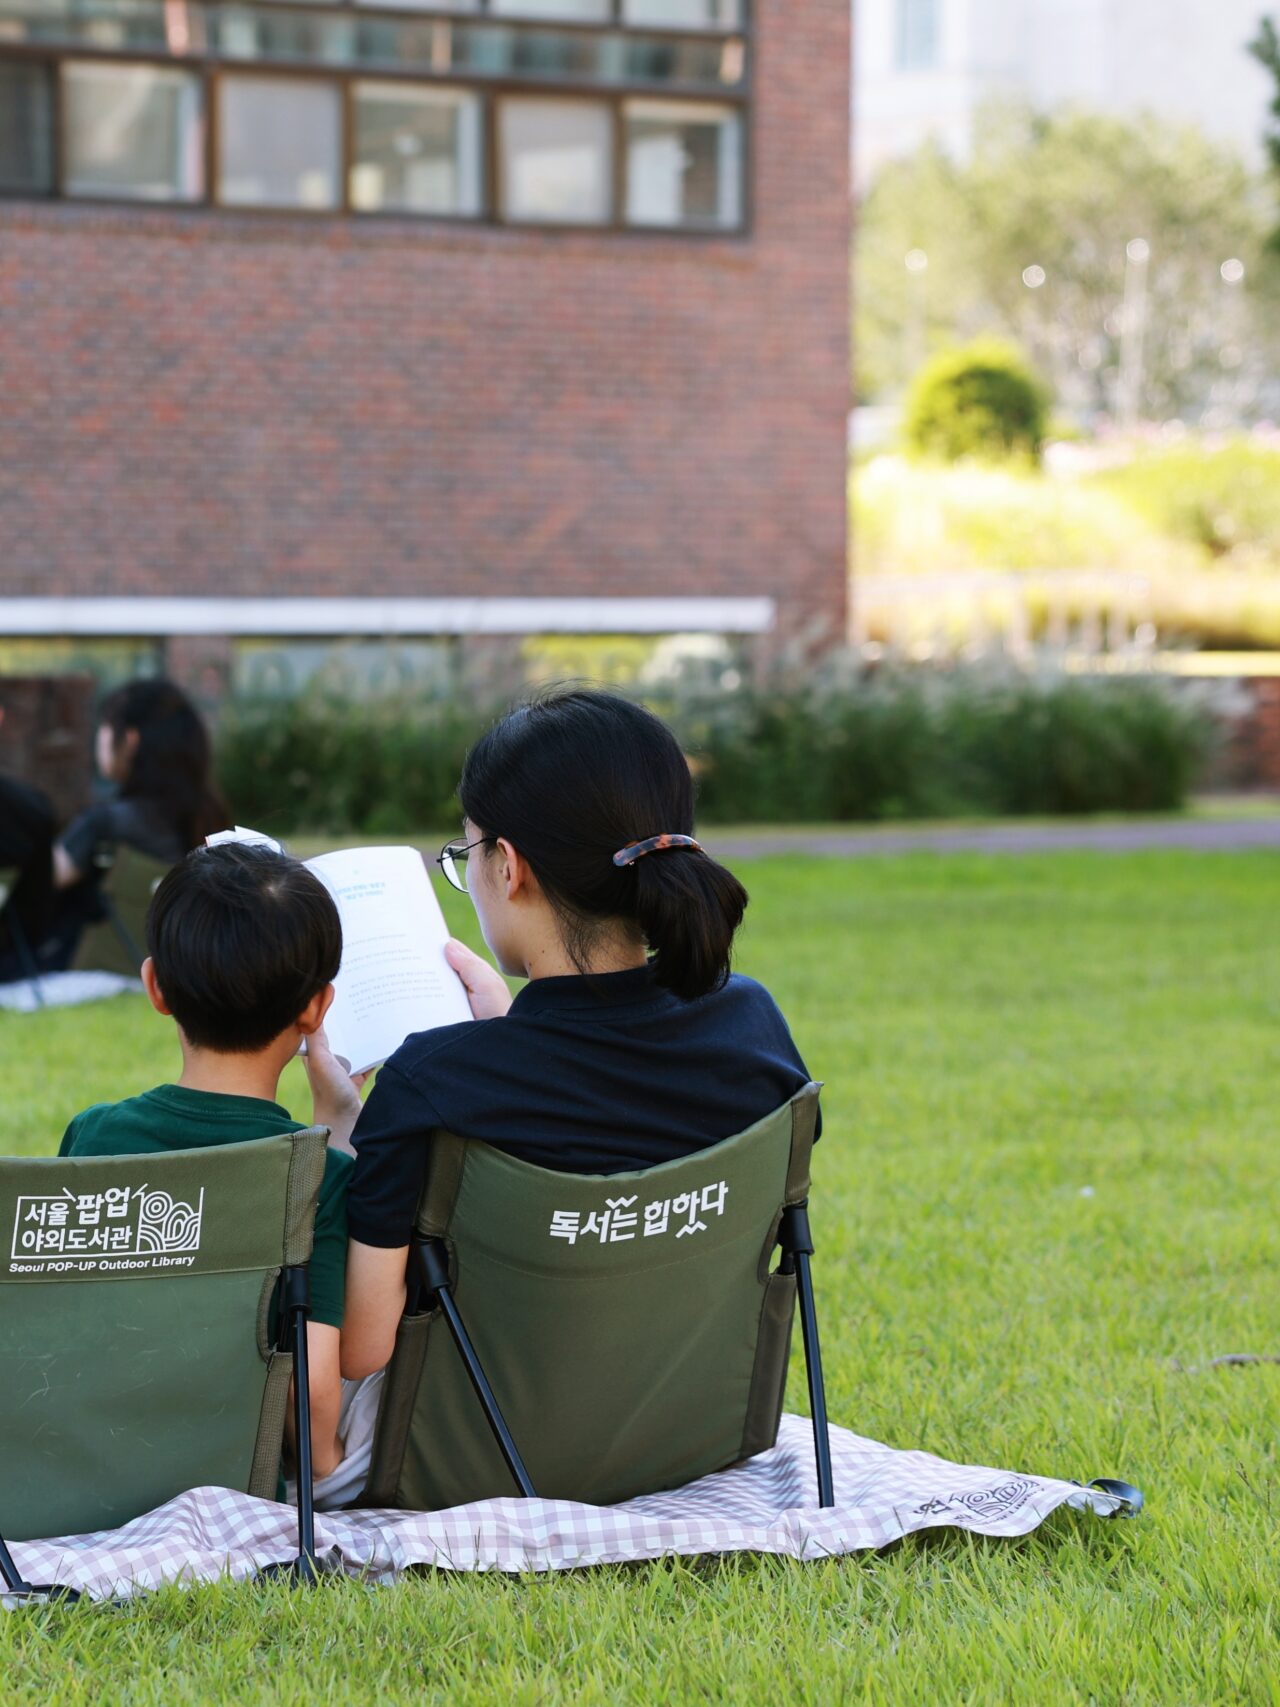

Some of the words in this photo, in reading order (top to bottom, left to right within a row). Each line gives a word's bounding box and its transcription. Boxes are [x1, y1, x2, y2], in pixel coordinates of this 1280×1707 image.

[24, 1202, 70, 1226] 서울
[75, 1186, 131, 1225] 팝업
[549, 1194, 638, 1245] 독서는
[643, 1180, 729, 1239] 힙하다
[21, 1225, 133, 1253] 야외도서관
[8, 1262, 44, 1273] Seoul
[46, 1261, 96, 1272] POP-UP
[99, 1259, 150, 1271] Outdoor
[151, 1255, 195, 1267] Library
